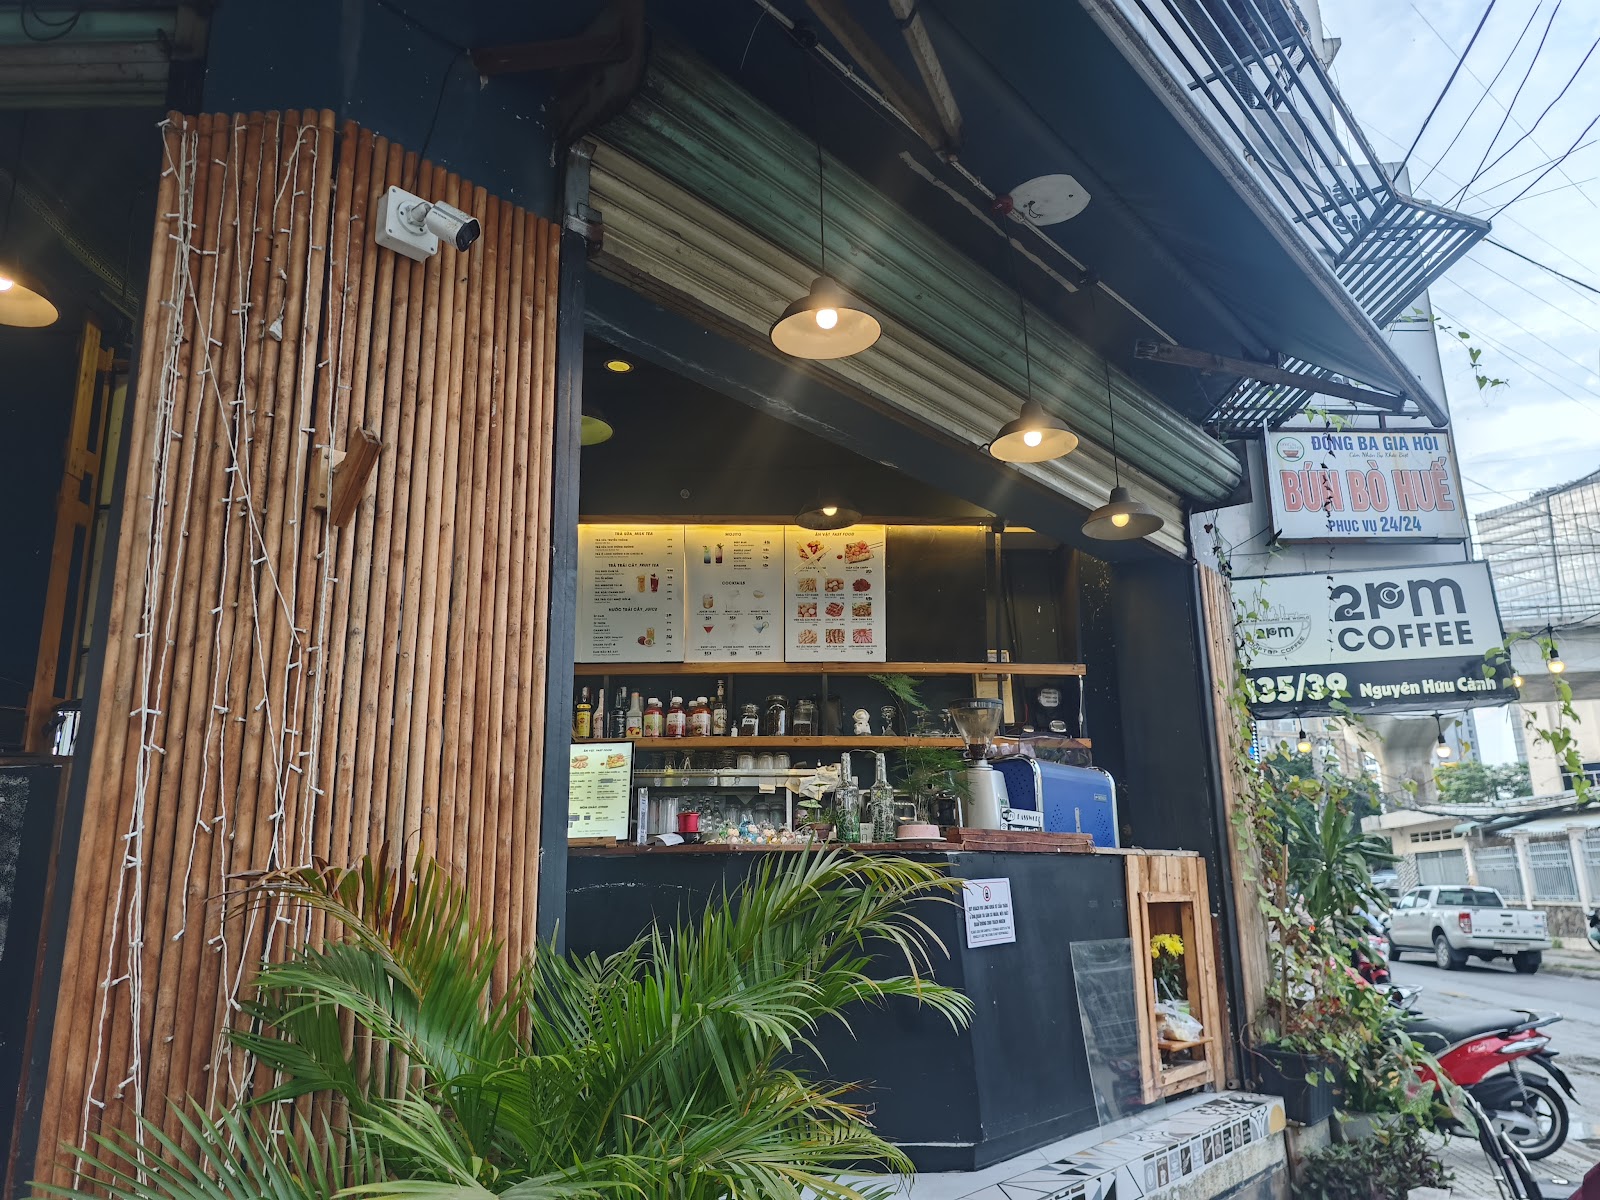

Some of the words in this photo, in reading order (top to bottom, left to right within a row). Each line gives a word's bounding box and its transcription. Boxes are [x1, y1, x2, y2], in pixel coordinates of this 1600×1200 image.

[1358, 437, 1379, 451] BA
[1383, 437, 1409, 451] GIA
[1413, 433, 1439, 454] HỘI
[1280, 461, 1345, 512] BÚN
[1346, 460, 1390, 512] BÒ
[1391, 456, 1456, 512] HUẾ
[1330, 520, 1359, 535] PHỤC
[1362, 519, 1377, 535] VỤ
[1380, 516, 1422, 532] 24/24
[1330, 578, 1467, 622] 2pm
[1337, 620, 1474, 652] COFFEE
[1246, 672, 1348, 704] 135/39
